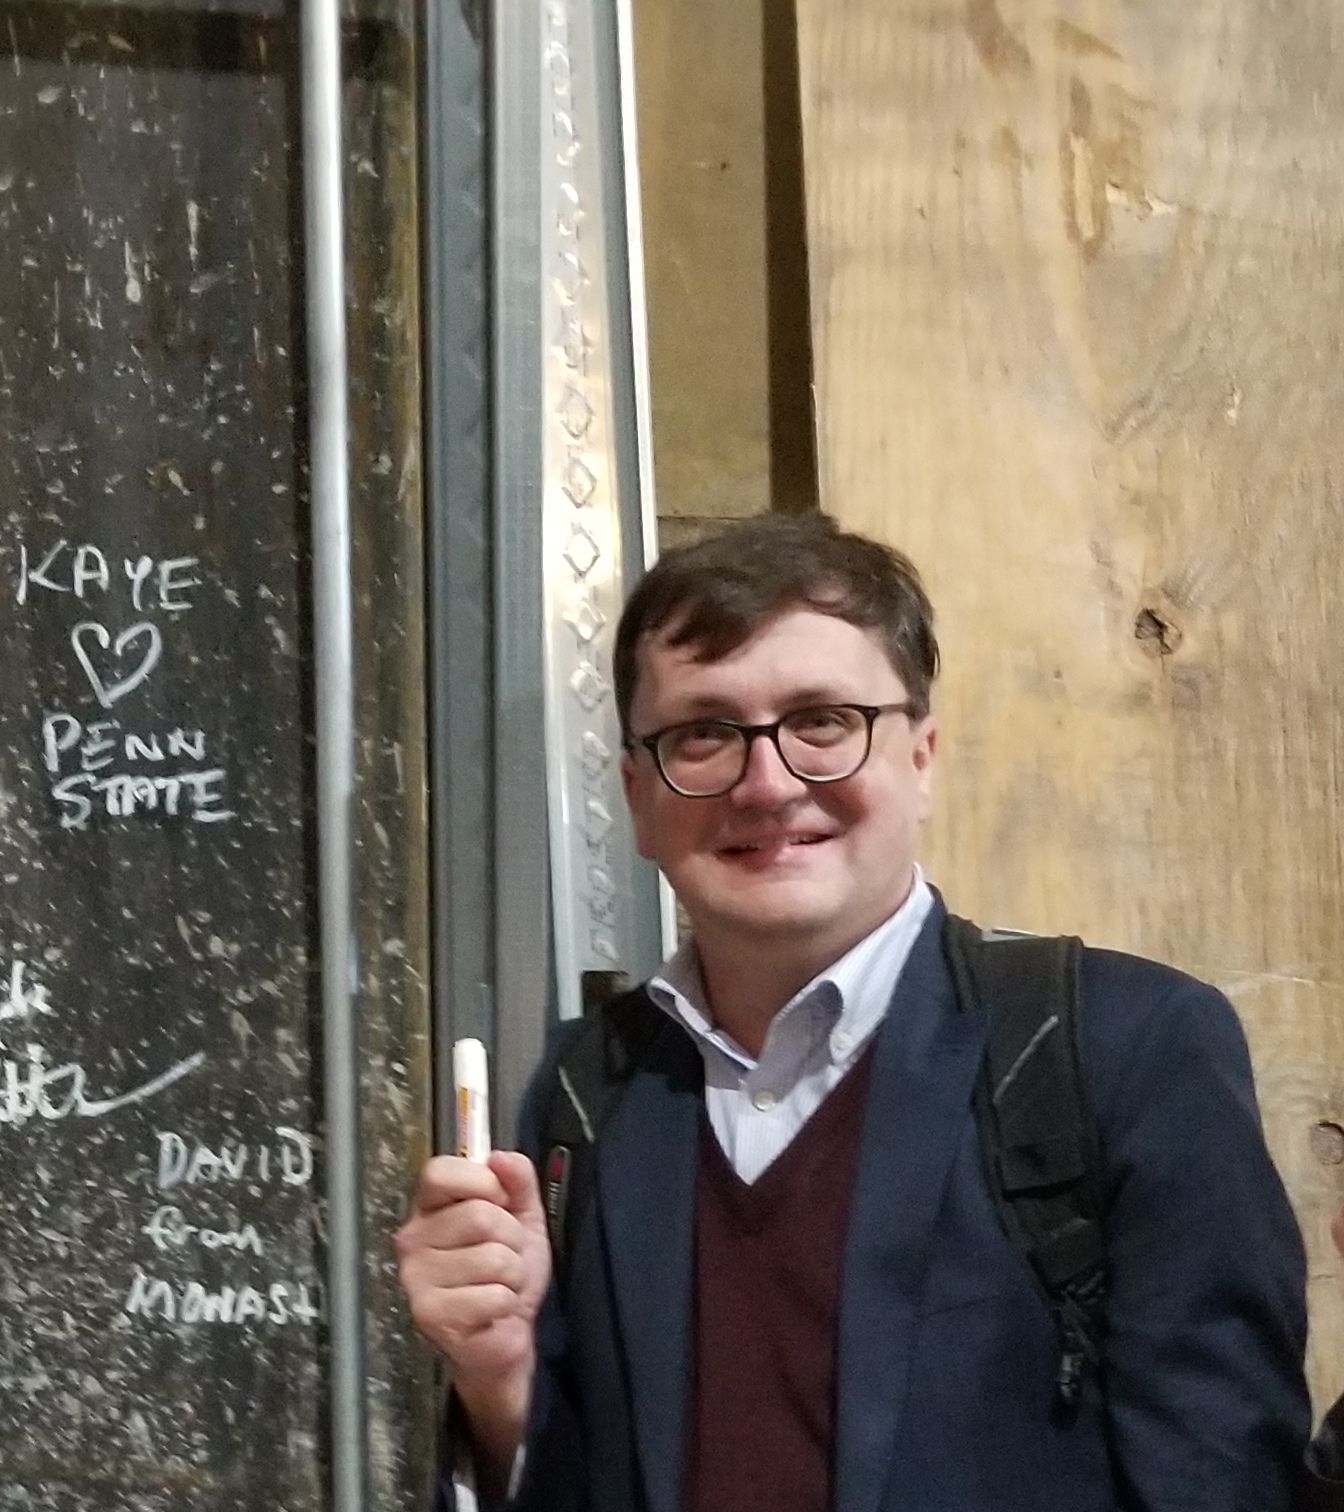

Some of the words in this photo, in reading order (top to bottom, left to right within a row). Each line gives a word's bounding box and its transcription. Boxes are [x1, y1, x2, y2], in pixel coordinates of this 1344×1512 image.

[15, 539, 203, 612] KAYE
[42, 713, 206, 773] PENN
[51, 768, 238, 831] STATE
[157, 1126, 314, 1190] DAVID
